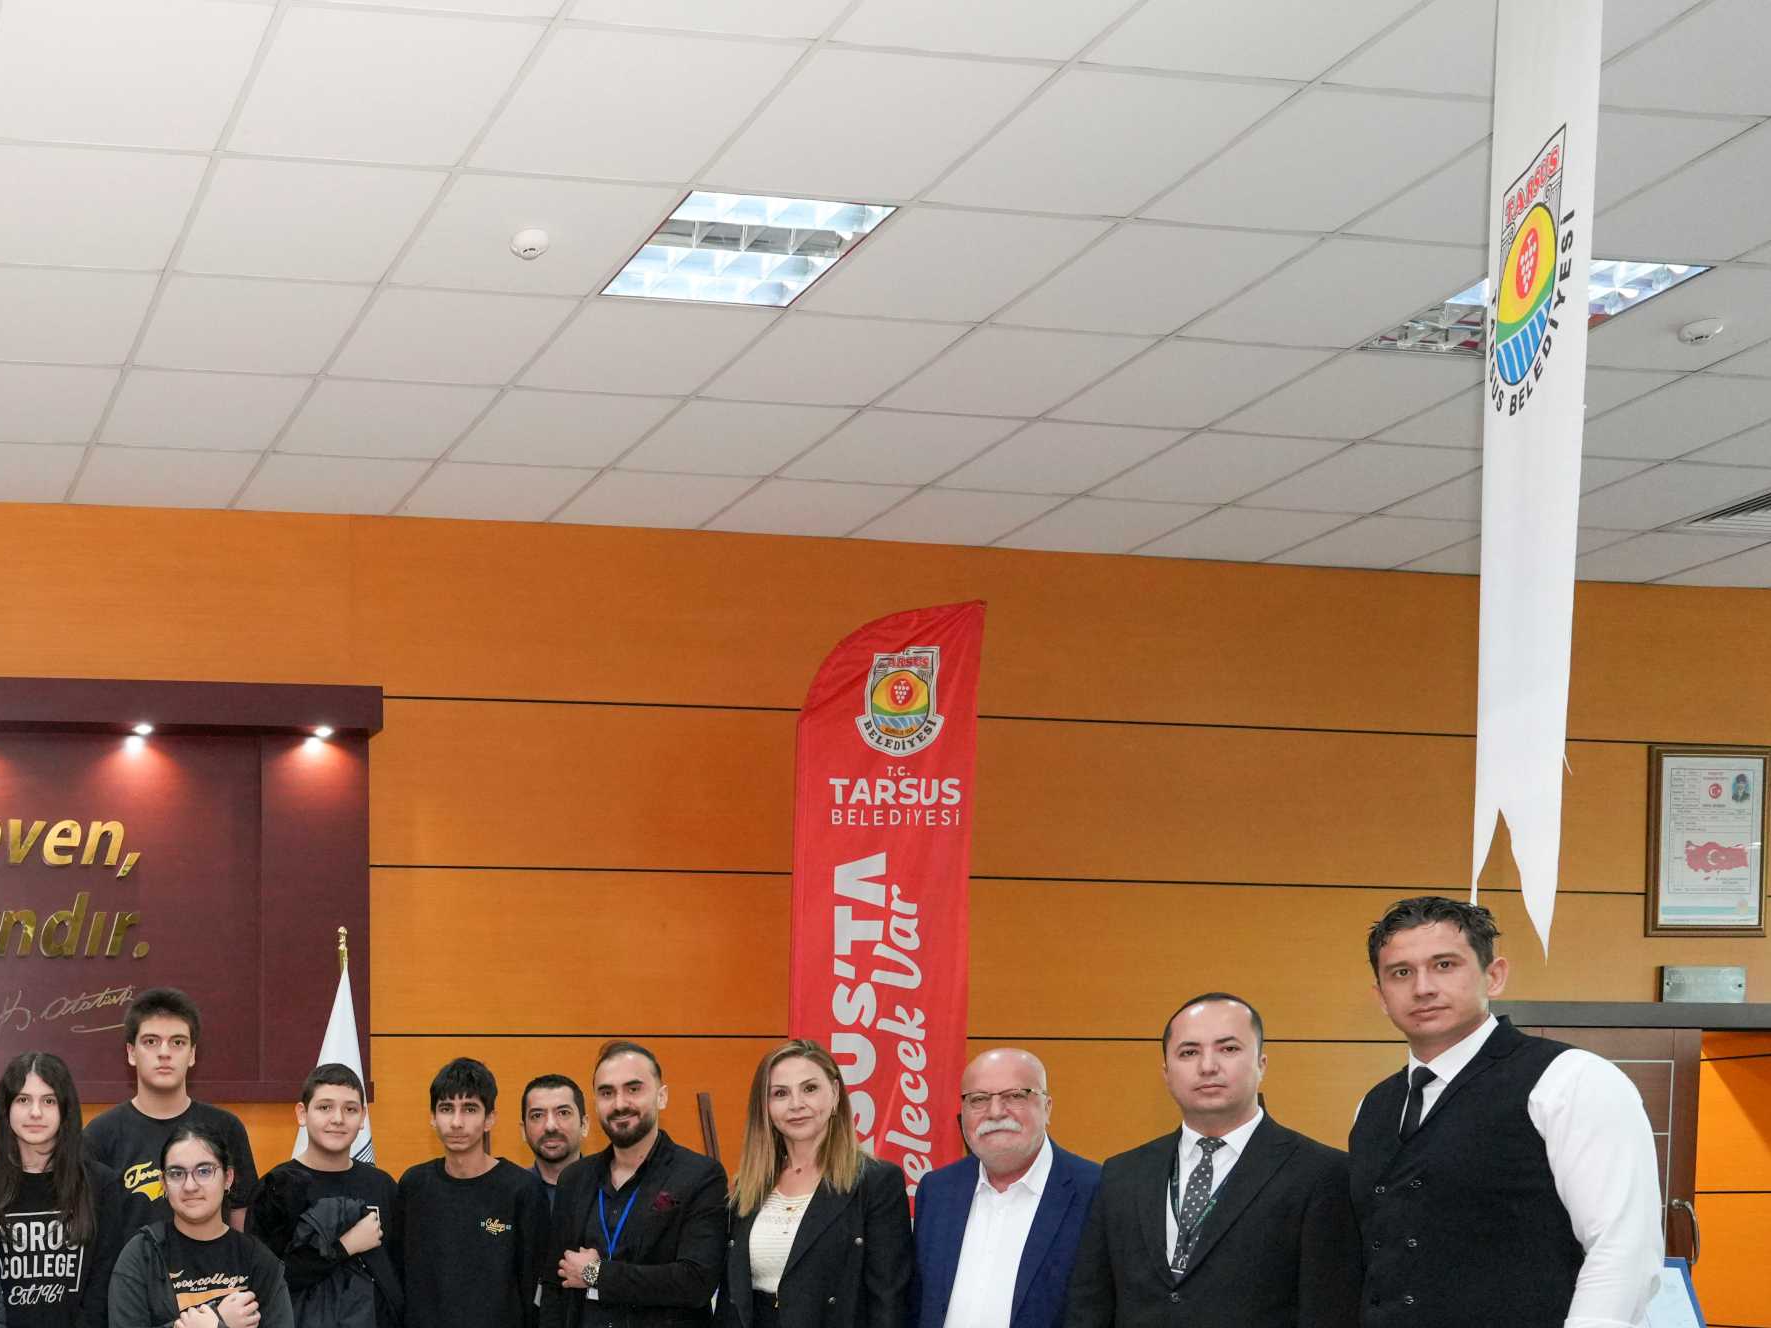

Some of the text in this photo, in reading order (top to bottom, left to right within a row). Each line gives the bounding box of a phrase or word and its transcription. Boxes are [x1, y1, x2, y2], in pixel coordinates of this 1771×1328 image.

[1505, 144, 1559, 225] TARSUS
[1509, 209, 1575, 417] BELEDİYESİ
[864, 719, 937, 751] BELEDİYESİ
[829, 778, 961, 806] TARSUS
[886, 766, 911, 777] T.C.
[831, 808, 960, 826] BELEDİYESİ
[831, 852, 887, 1156] SUS'TA
[870, 884, 933, 1197] elecek Var
